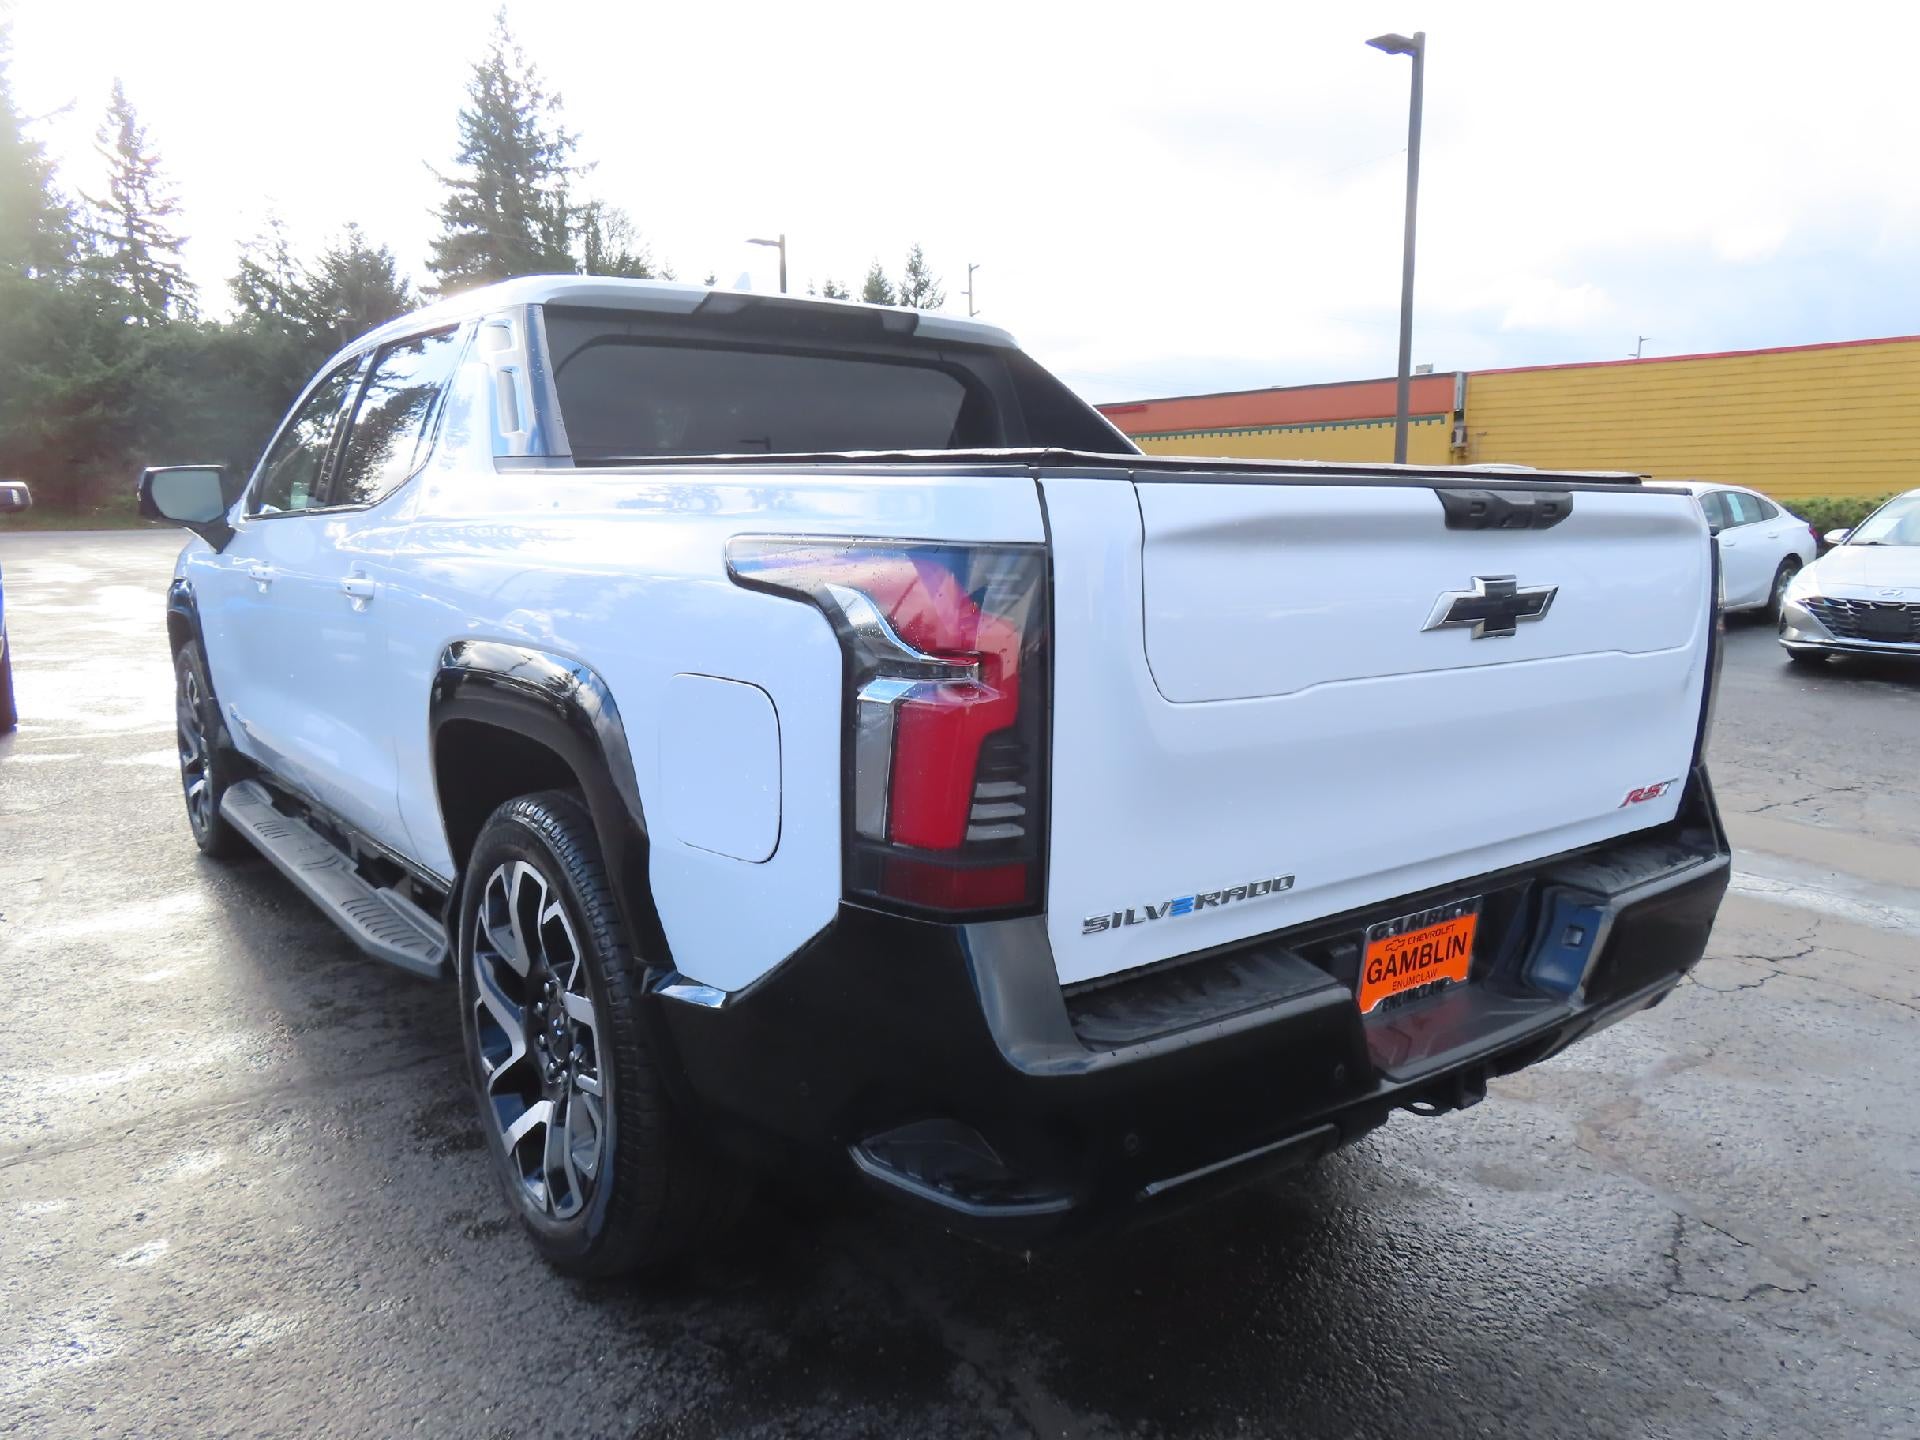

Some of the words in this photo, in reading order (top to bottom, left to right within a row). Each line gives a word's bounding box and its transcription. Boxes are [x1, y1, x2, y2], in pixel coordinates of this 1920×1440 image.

[1617, 777, 1679, 805] RST
[1082, 872, 1296, 935] SILVERADO
[1366, 931, 1468, 985] GAMBLIN
